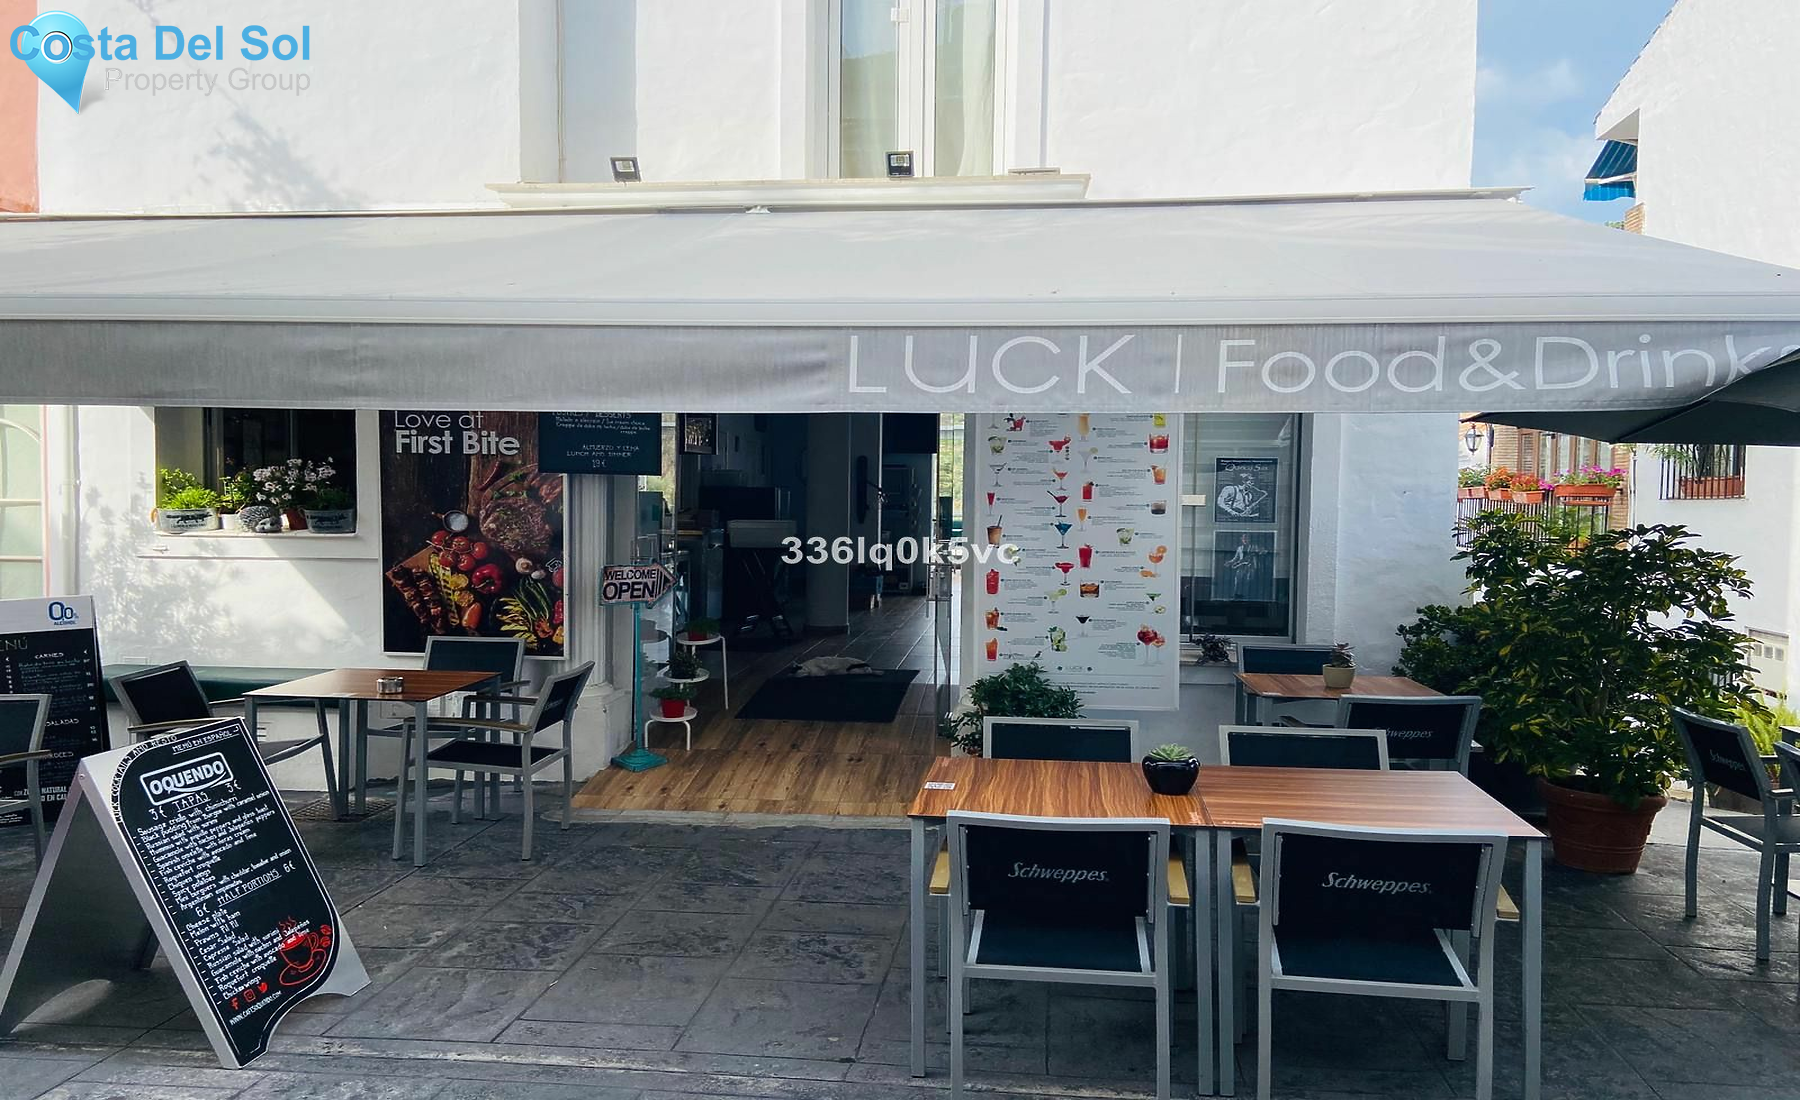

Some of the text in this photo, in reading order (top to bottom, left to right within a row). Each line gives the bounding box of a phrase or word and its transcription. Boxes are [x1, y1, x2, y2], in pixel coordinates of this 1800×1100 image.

[848, 333, 1136, 396] LUCK
[394, 411, 484, 429] Love at
[395, 430, 521, 456] First Bite
[605, 568, 657, 581] WELCOME
[603, 580, 656, 600] OPEN
[150, 761, 226, 794] OQUENDO
[172, 792, 208, 810] TAPAS
[161, 823, 188, 838] pudding
[242, 869, 279, 892] PORTIONS
[1008, 862, 1108, 883] Schweppes
[1322, 872, 1431, 894] Schweppes
[186, 917, 210, 931] Cheese
[189, 926, 210, 939] Melon
[217, 931, 236, 946] Salad
[231, 933, 250, 946] Salad
